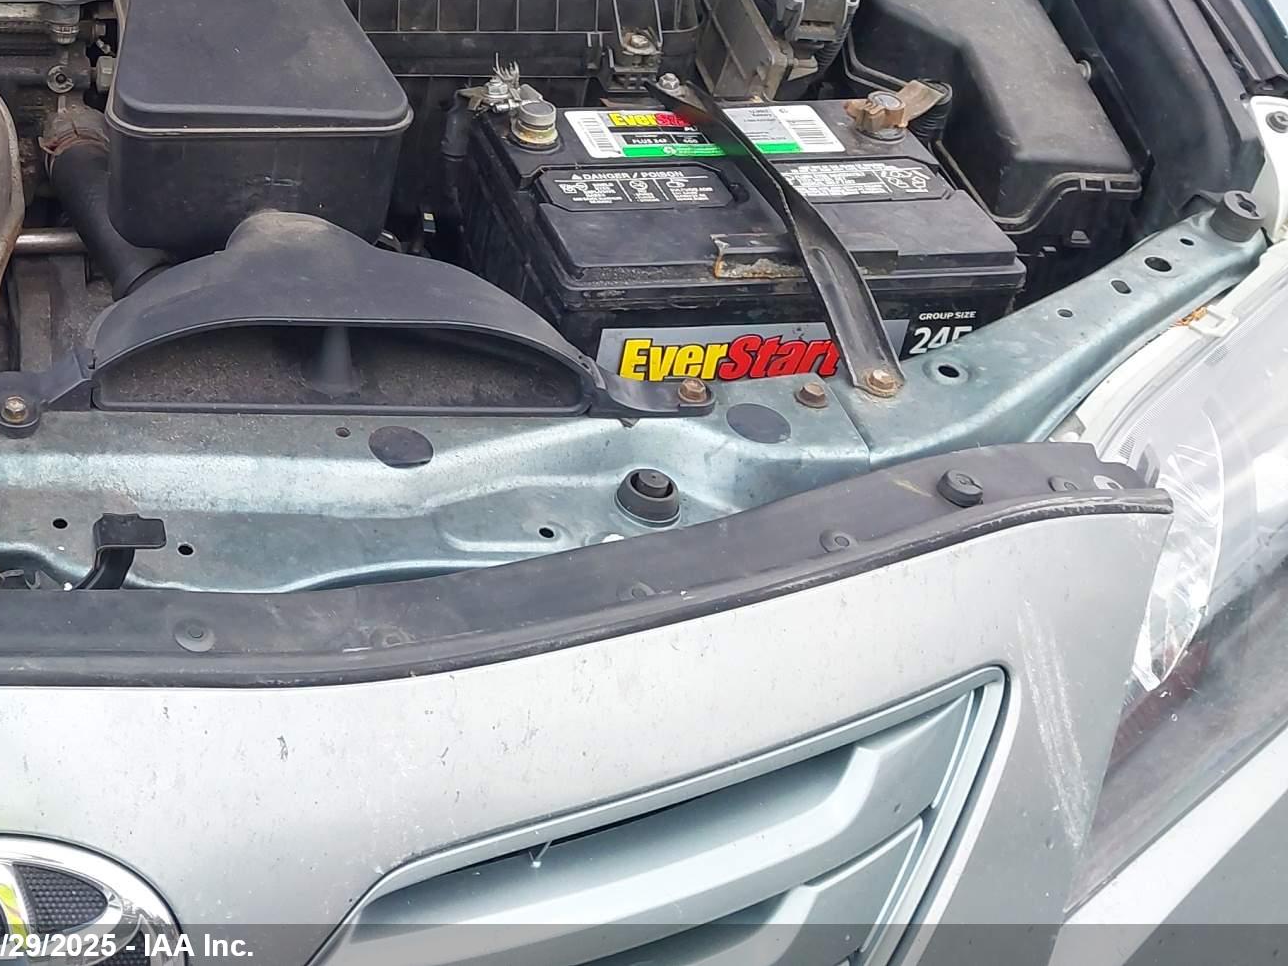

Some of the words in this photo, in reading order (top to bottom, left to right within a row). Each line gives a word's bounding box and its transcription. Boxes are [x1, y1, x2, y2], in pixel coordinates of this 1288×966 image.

[582, 172, 630, 180] DANGER
[641, 170, 684, 178] POISON
[918, 312, 954, 321] GROUP
[954, 310, 977, 319] SIZE
